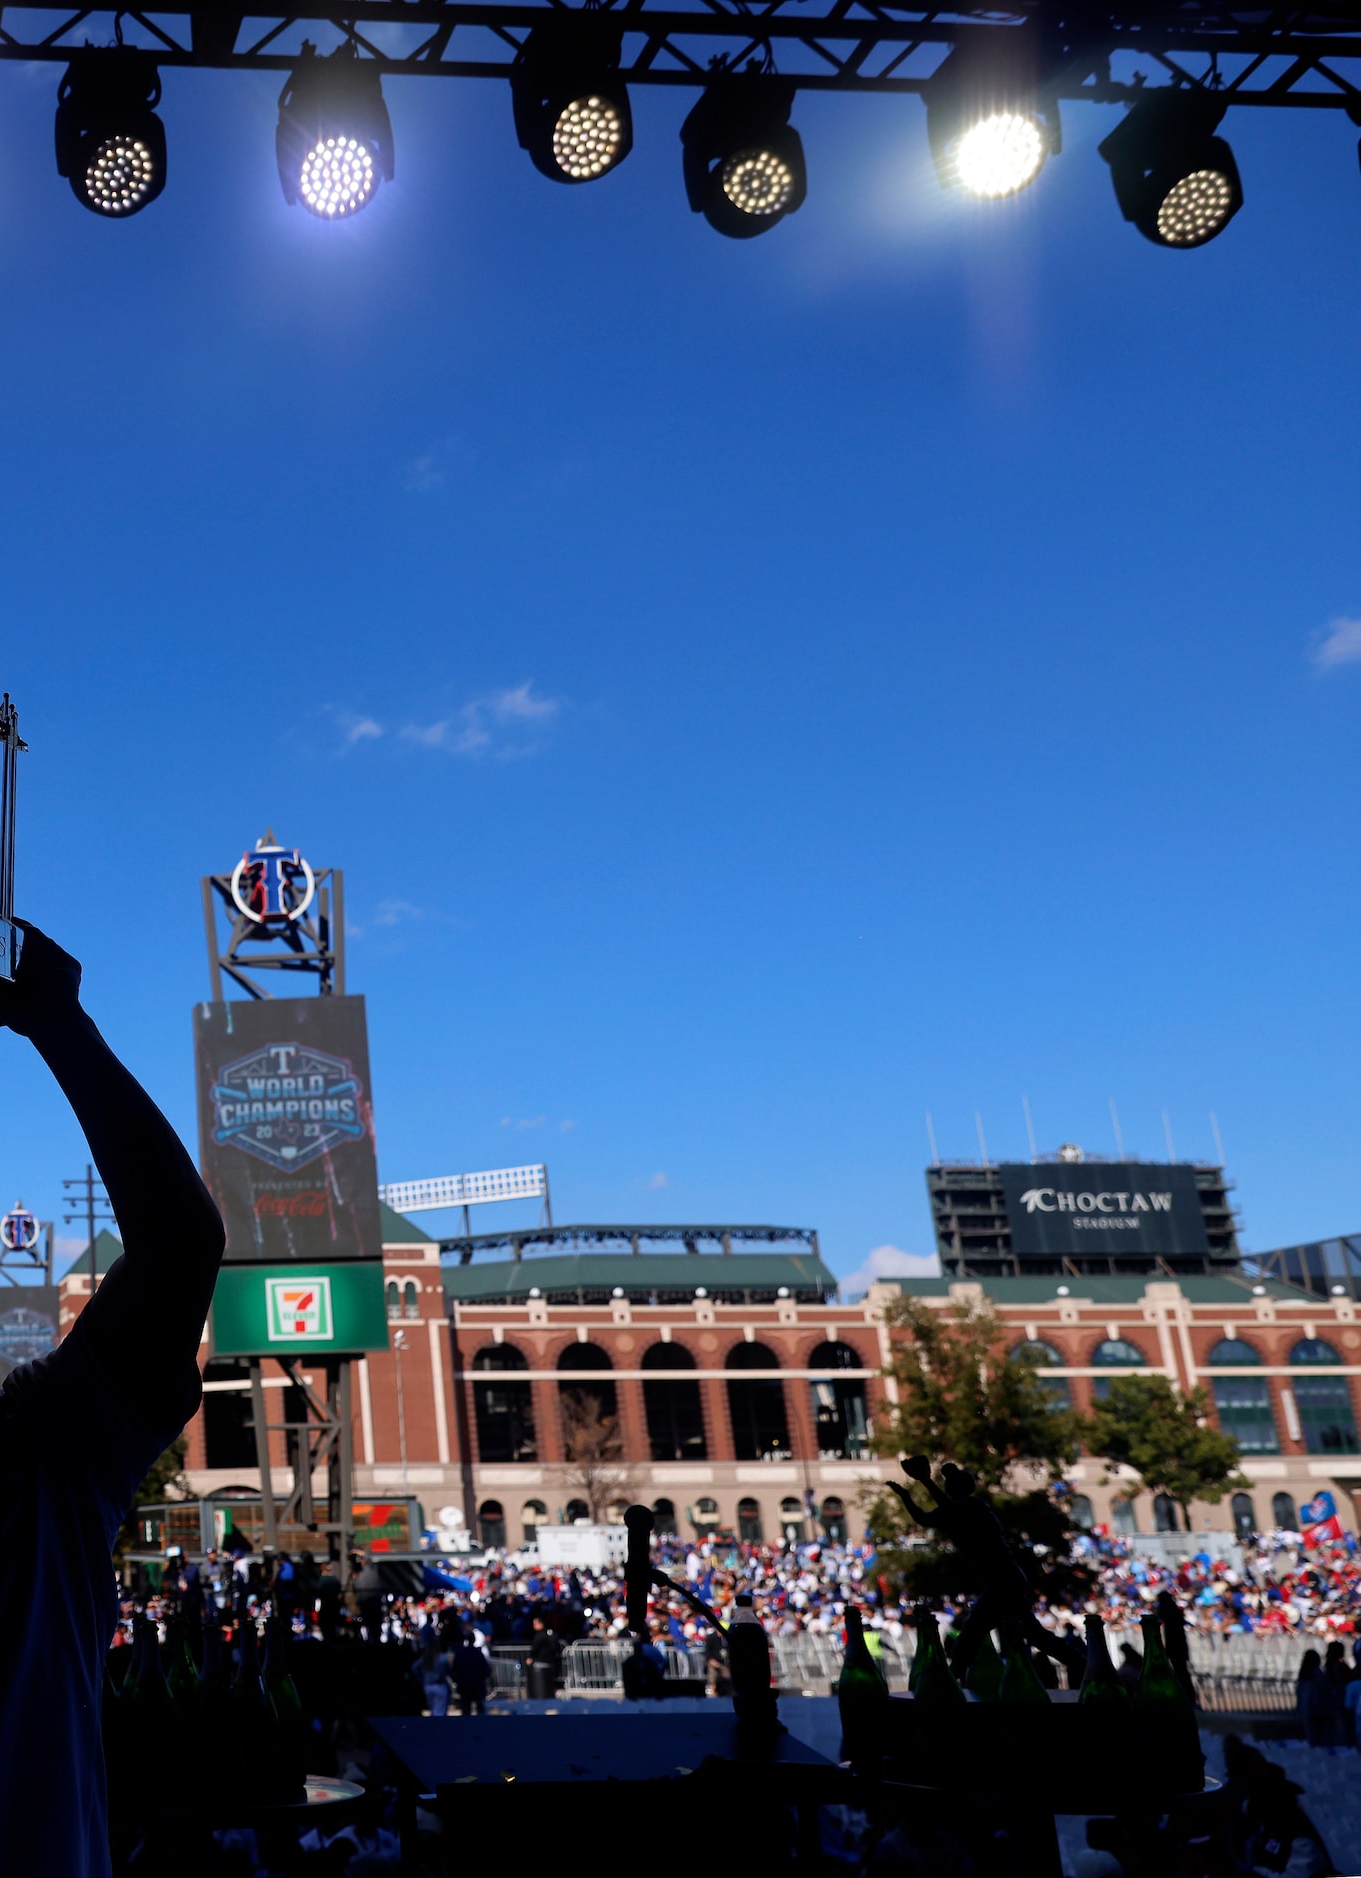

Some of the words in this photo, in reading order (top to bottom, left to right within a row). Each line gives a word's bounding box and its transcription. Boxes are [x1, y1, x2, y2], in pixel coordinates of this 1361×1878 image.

[270, 1047, 295, 1074] T
[247, 1075, 324, 1098] WORLD
[220, 1099, 355, 1127] CHAMPIONS
[256, 1126, 272, 1138] 20
[1036, 1187, 1173, 1213] CHOCTAW
[1072, 1216, 1140, 1230] STADIUM
